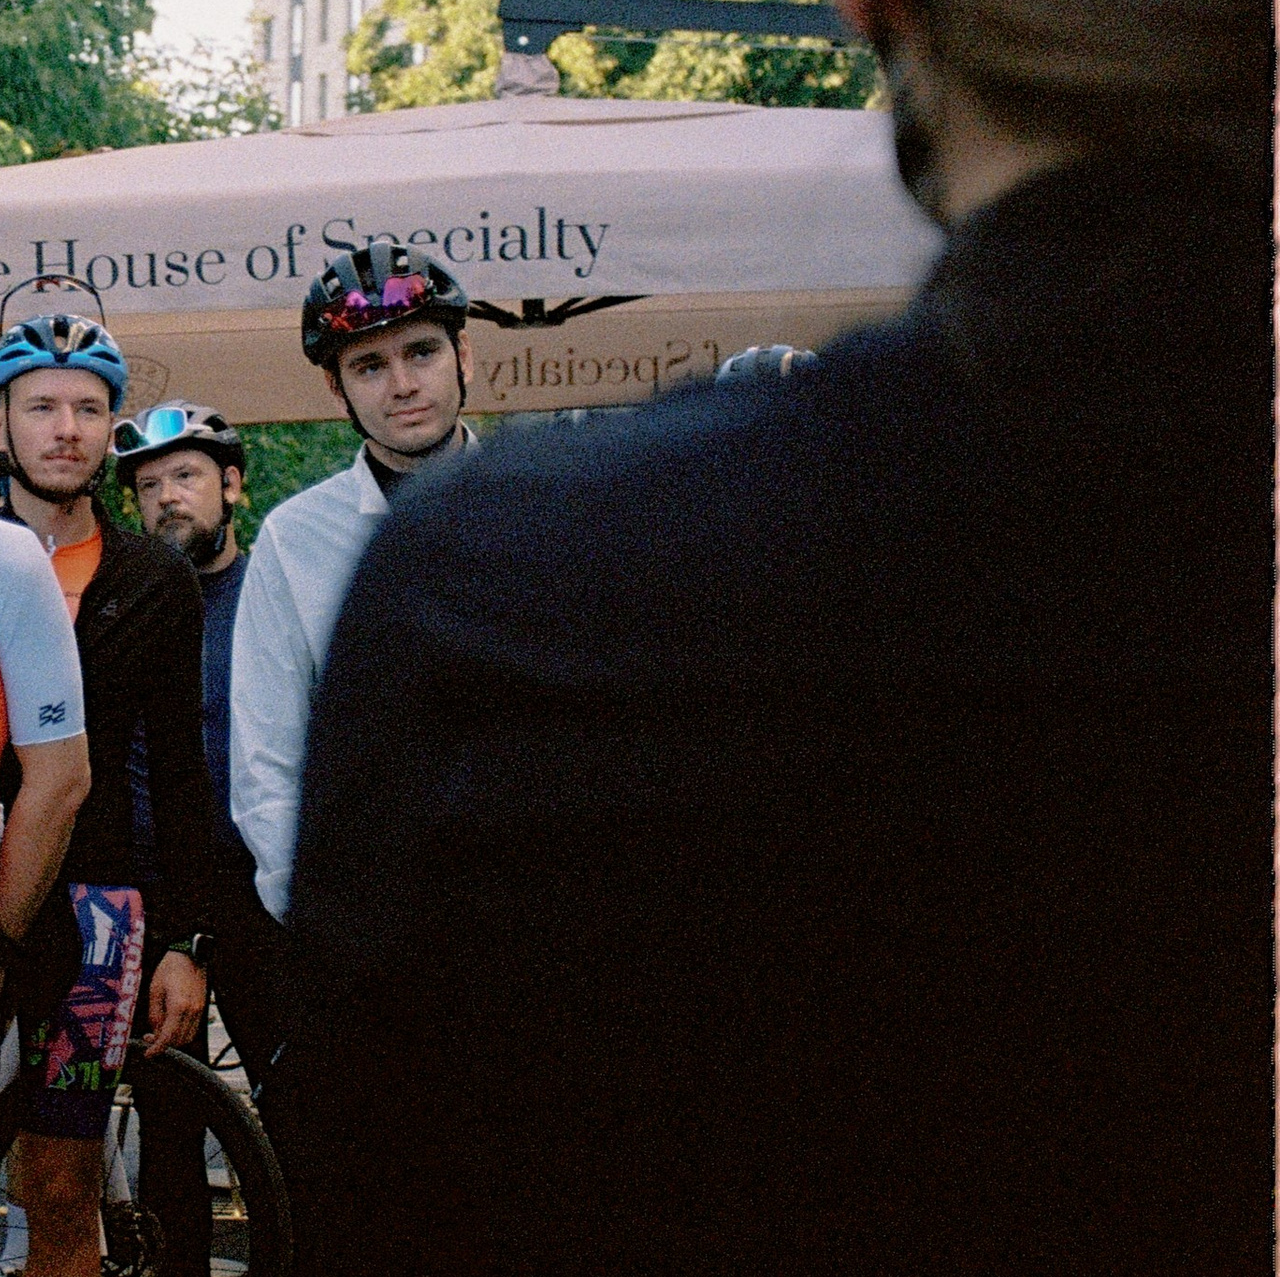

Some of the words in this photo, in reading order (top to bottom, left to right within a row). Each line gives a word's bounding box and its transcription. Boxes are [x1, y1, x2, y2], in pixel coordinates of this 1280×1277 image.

[30, 239, 227, 294] House
[245, 224, 307, 281] of
[322, 207, 610, 278] Scialty
